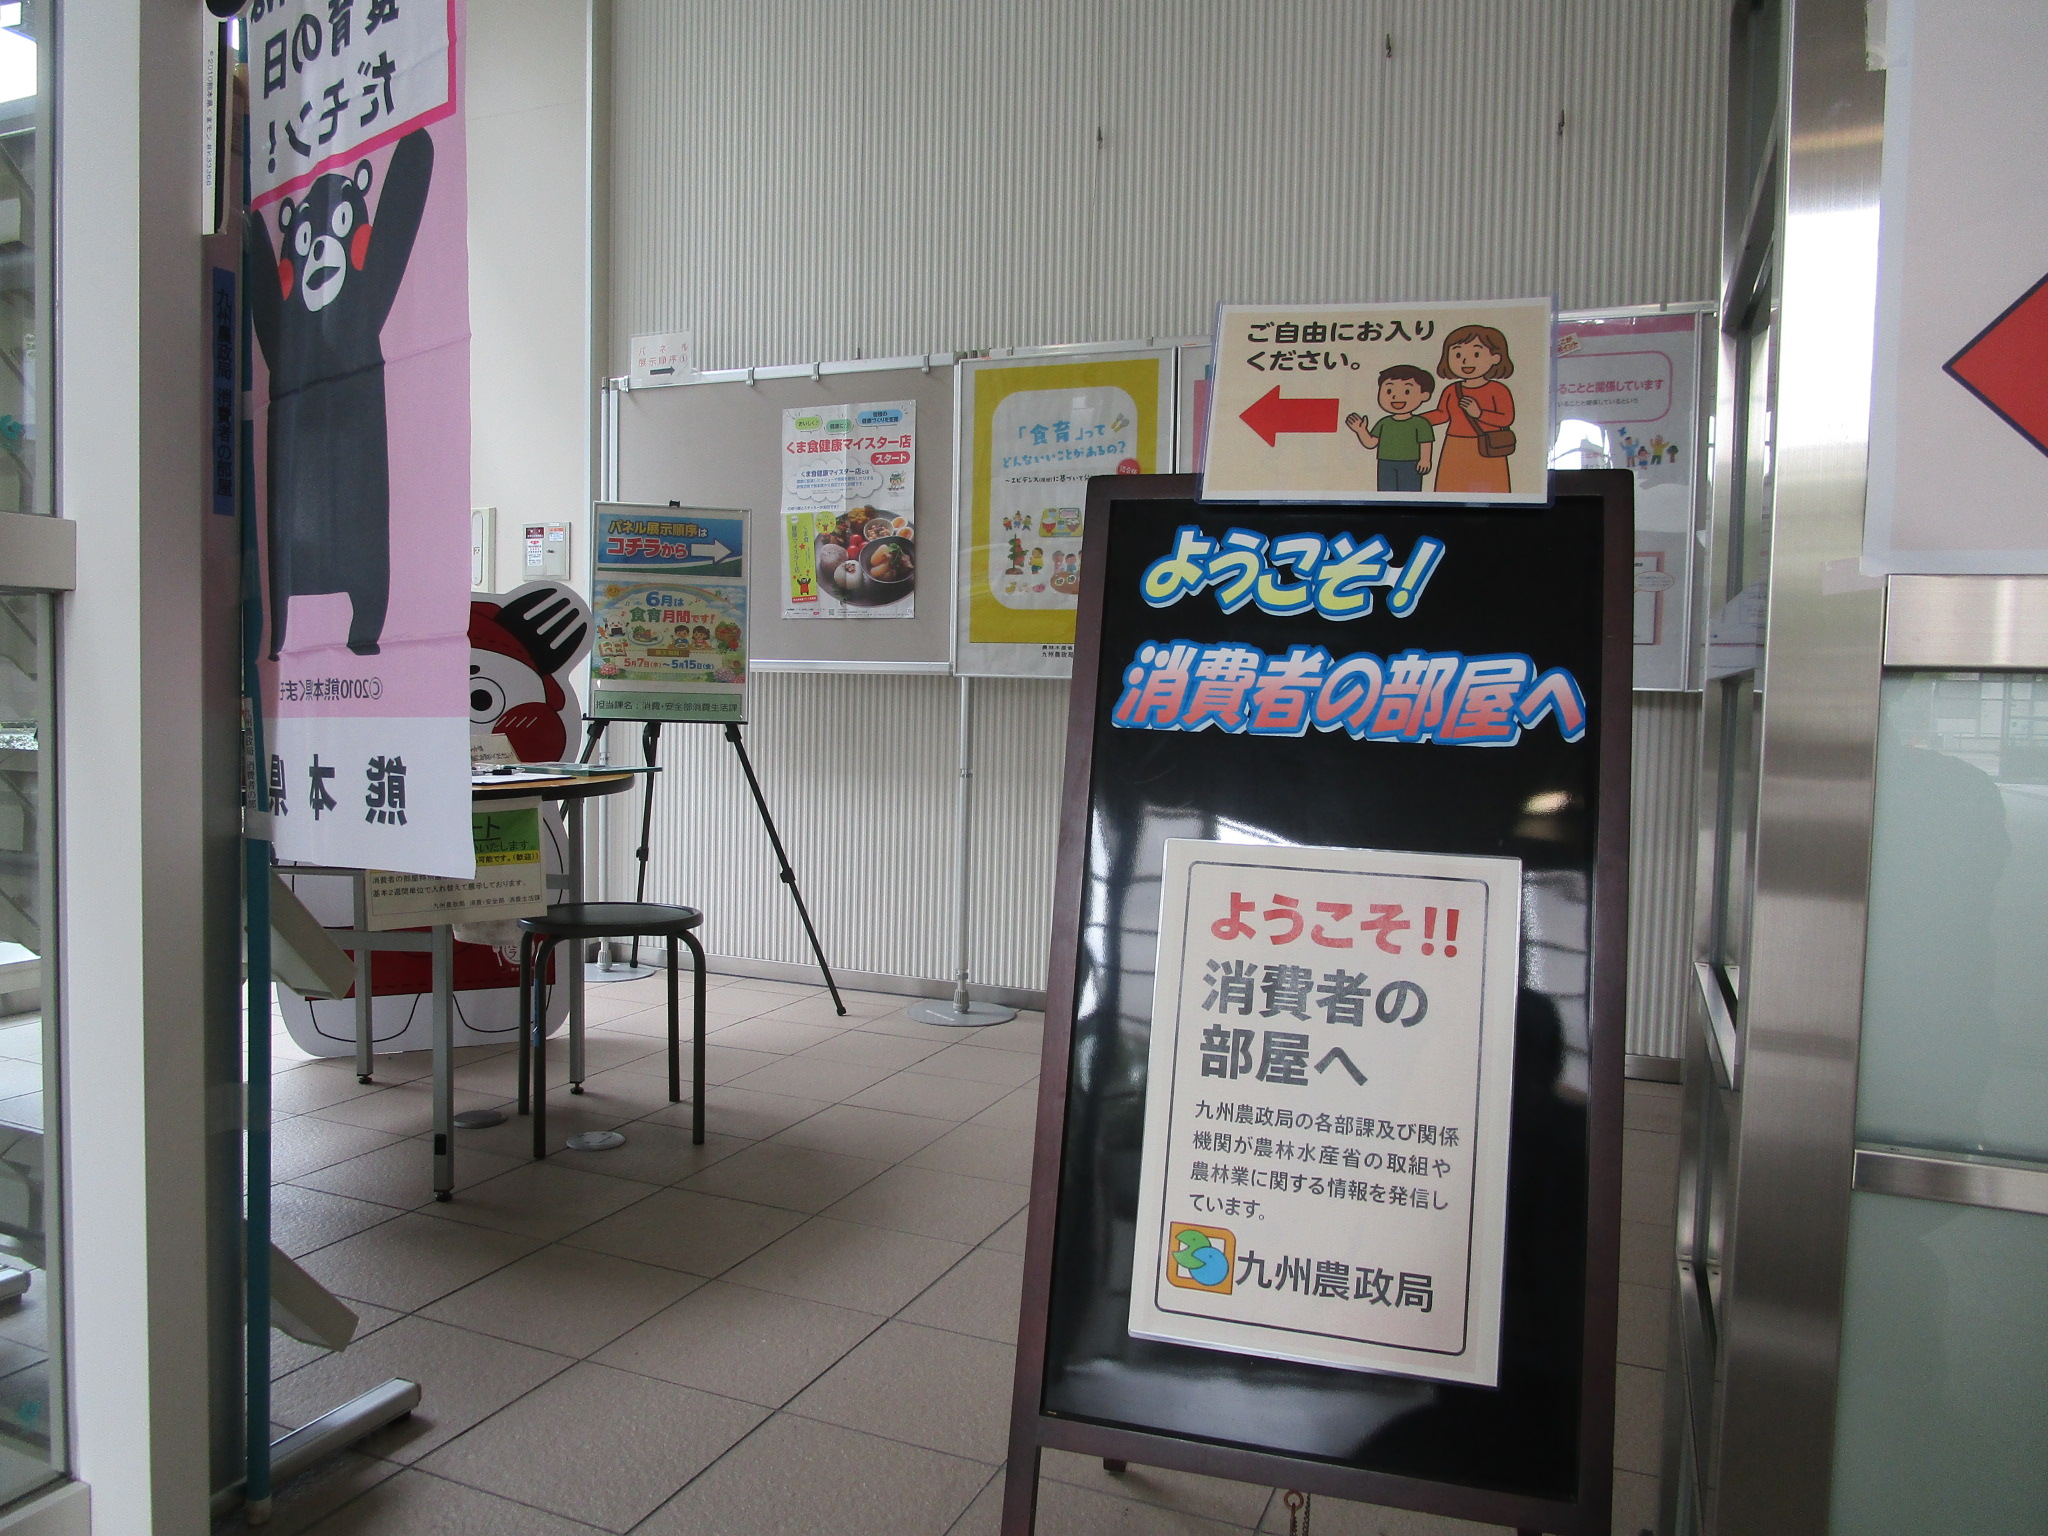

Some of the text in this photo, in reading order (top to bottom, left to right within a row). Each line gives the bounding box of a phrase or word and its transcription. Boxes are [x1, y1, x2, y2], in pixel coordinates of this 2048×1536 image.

[1246, 319, 1435, 344] ご自由にお入り
[1246, 350, 1361, 371] ください。
[217, 288, 233, 497] 九州農政局 消費者の部屋
[786, 434, 912, 454] くま食健康マイスター店
[1017, 420, 1106, 446] 「食育」って
[875, 453, 907, 464] スタート
[1002, 440, 1127, 469] どんないいことがあるの?
[607, 519, 709, 538] パネル展示順序は
[606, 537, 688, 559] コチラから
[1140, 524, 1446, 621] ようこそ!
[645, 590, 685, 608] 6月は
[629, 606, 716, 624] 食育月間です!
[1111, 638, 1586, 747] 消費者の部屋へ
[476, 853, 539, 864] 可能です。(歓迎))
[372, 874, 447, 884] 消費者の部屋特別
[1210, 891, 1460, 958] ようこそ!!
[1200, 958, 1429, 1028] 消費者の
[1199, 1023, 1369, 1087] 部屋へ
[1194, 1099, 1459, 1148] 九州農政局の各部課及び関係
[1192, 1129, 1451, 1179] 機関が農林水産省の取組や
[1190, 1160, 1449, 1210] 農林業に関する情報を発信し
[1188, 1192, 1266, 1221] ています。
[1235, 1249, 1434, 1314] 九州農政局
